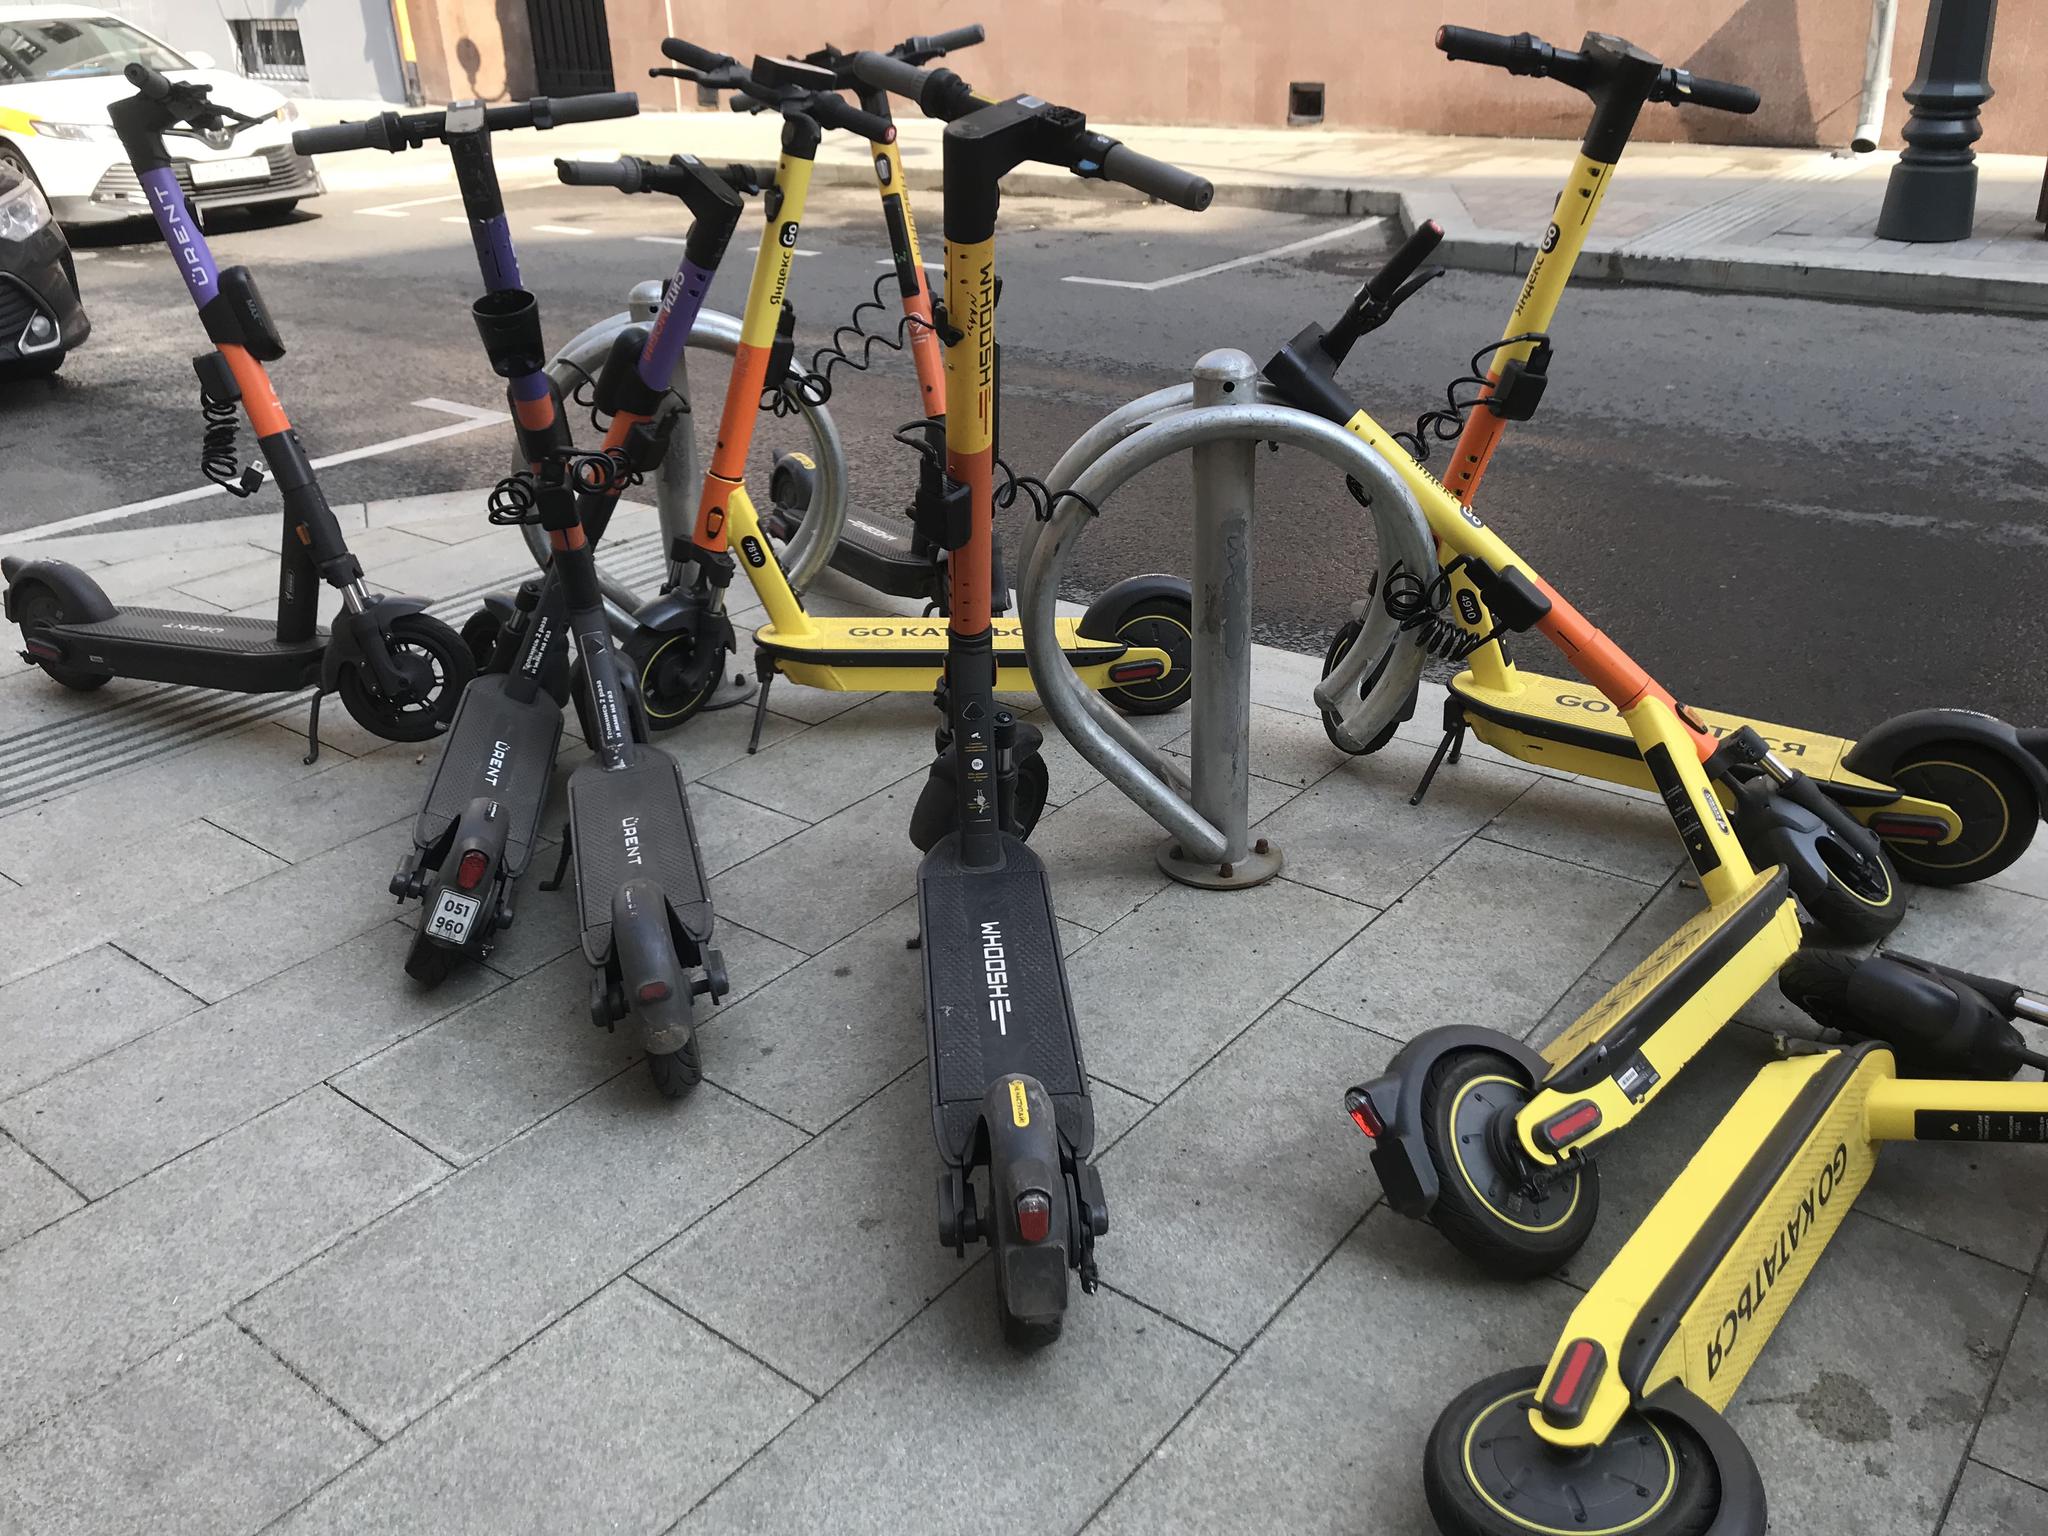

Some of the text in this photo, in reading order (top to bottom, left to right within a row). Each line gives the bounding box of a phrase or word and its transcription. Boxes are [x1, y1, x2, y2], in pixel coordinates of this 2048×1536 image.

[1543, 226, 1557, 249] Go
[770, 224, 797, 304] Яндекс Go
[979, 261, 992, 387] WHOOSH
[745, 540, 761, 563] 7810
[1462, 595, 1476, 619] 4910
[849, 627, 894, 637] GO
[1556, 694, 1610, 713] GO
[444, 900, 471, 918] 051
[435, 916, 464, 935] 960
[981, 921, 1009, 998] WHOOSH
[1707, 1142, 1847, 1382] GO КАТАТЬСЯ
